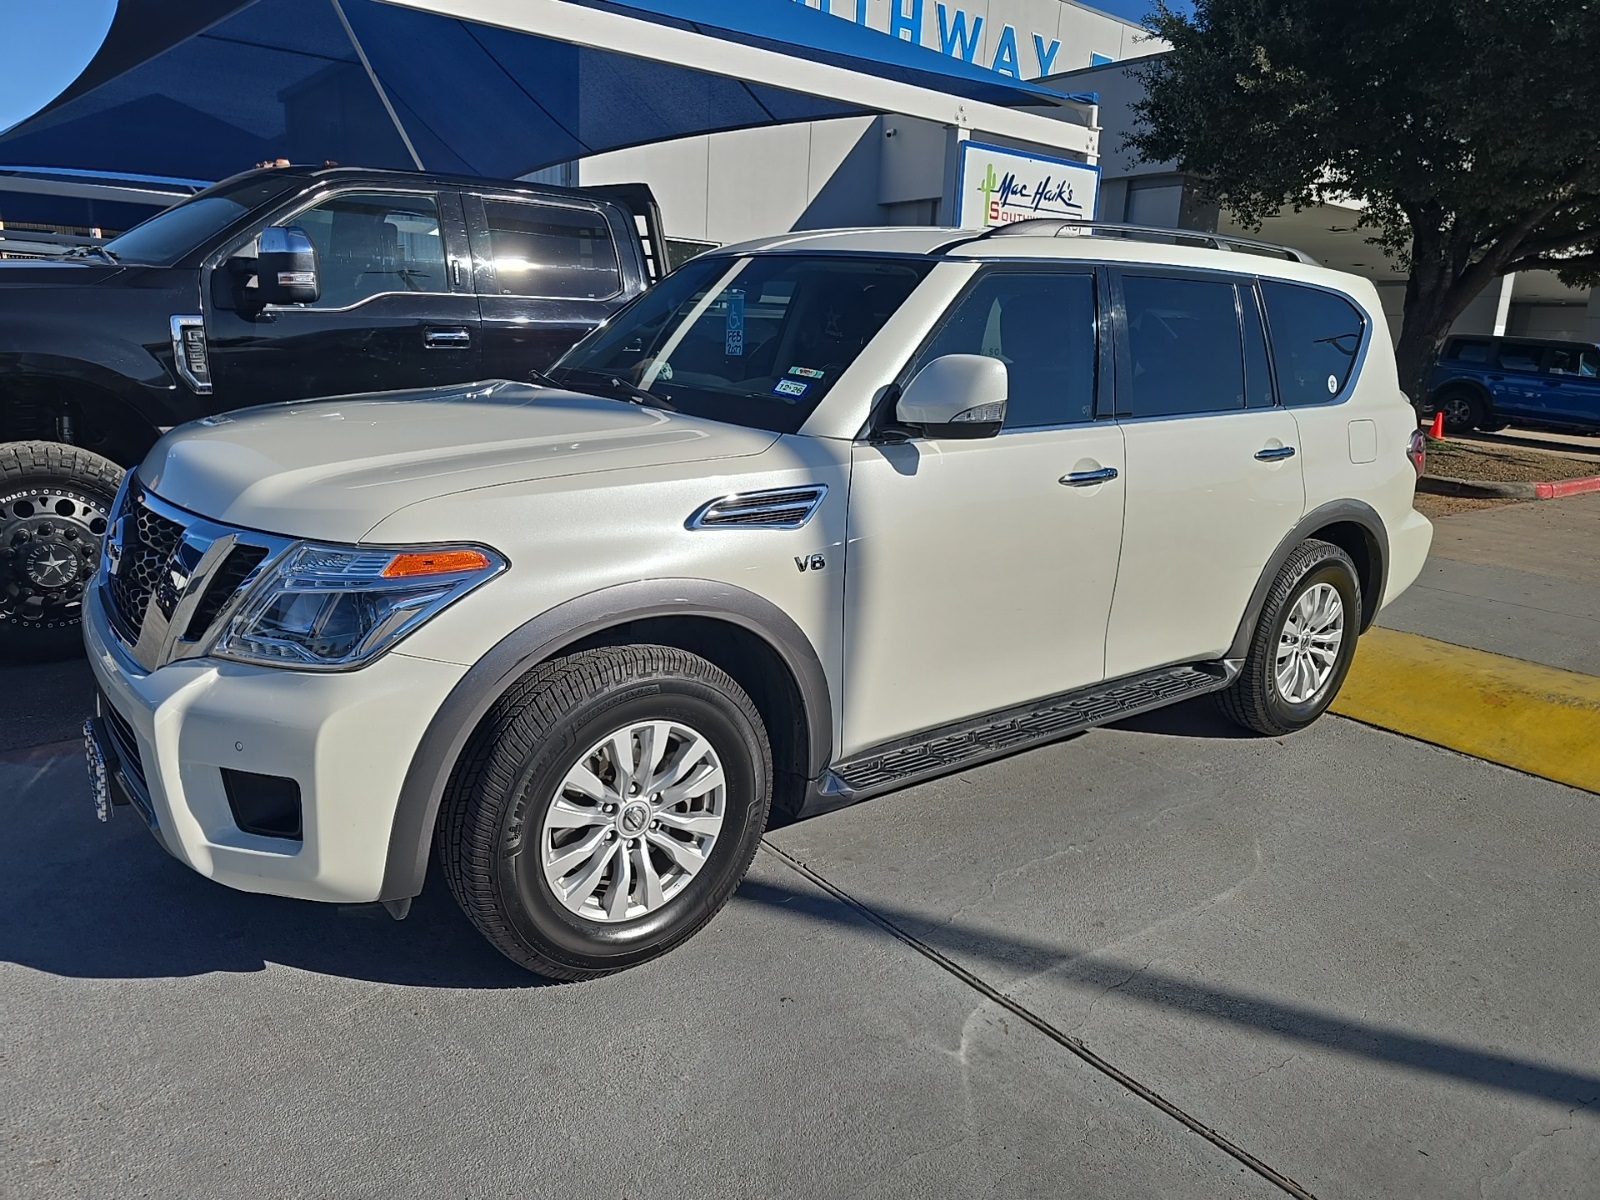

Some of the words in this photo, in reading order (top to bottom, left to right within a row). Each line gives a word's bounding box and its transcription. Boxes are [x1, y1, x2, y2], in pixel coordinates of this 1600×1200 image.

[993, 171, 1032, 208] Mac
[1030, 175, 1083, 212] Haik's
[727, 330, 742, 343] FEB
